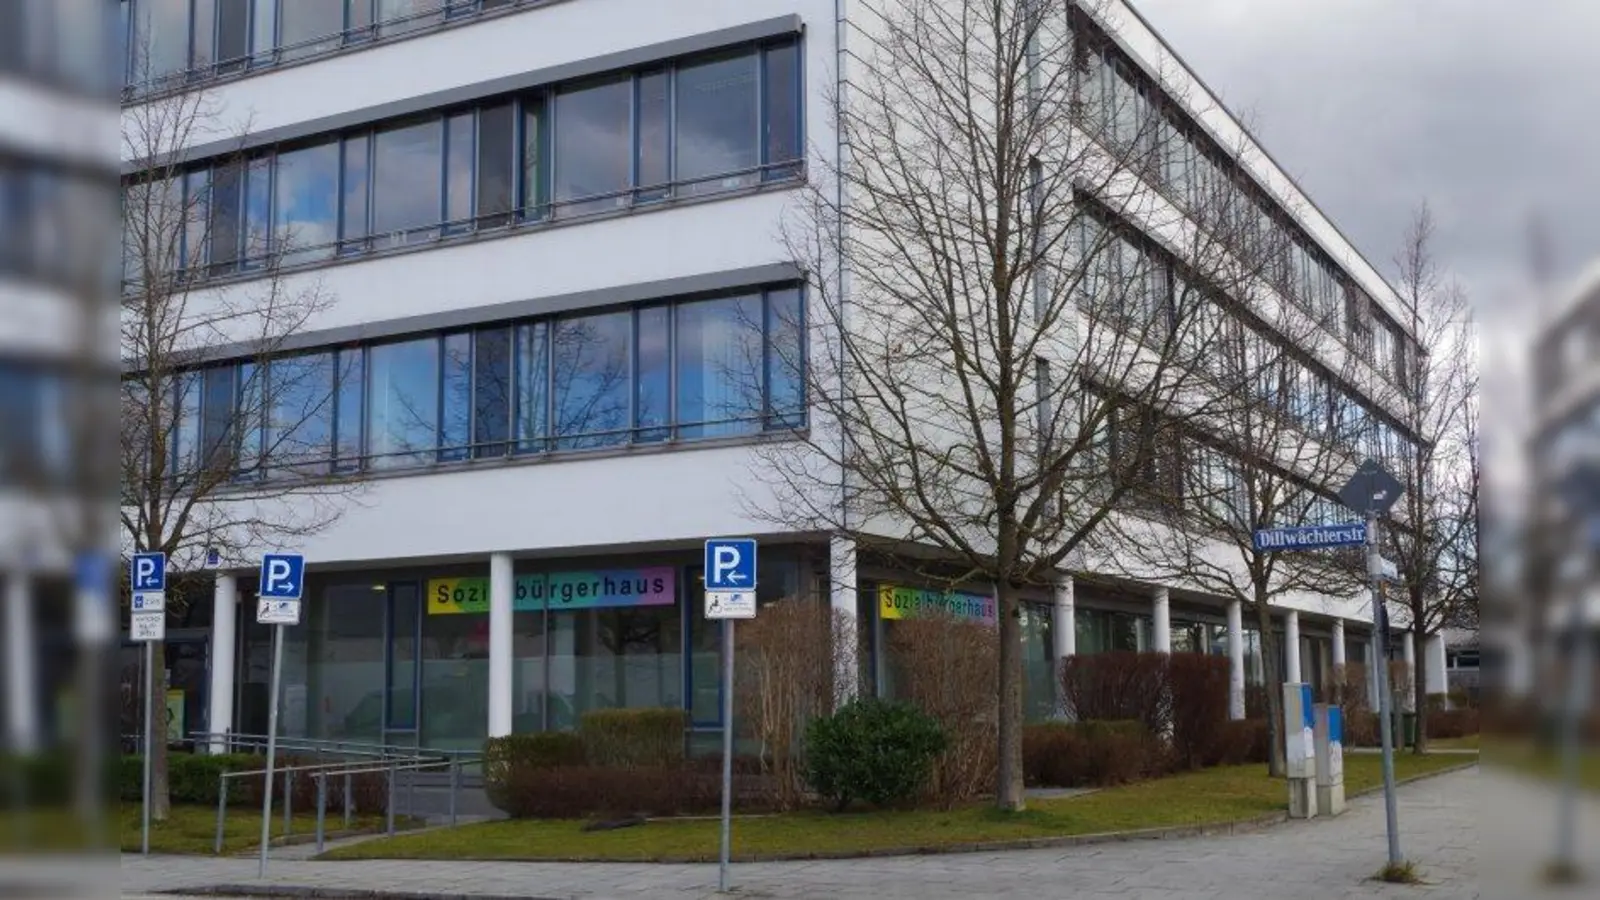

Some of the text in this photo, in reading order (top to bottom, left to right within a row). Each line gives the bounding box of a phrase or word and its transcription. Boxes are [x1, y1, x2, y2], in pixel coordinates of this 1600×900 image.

[137, 558, 155, 587] P
[266, 559, 291, 592] P
[713, 546, 740, 583] P
[437, 575, 664, 604] Sozibürgerhaus
